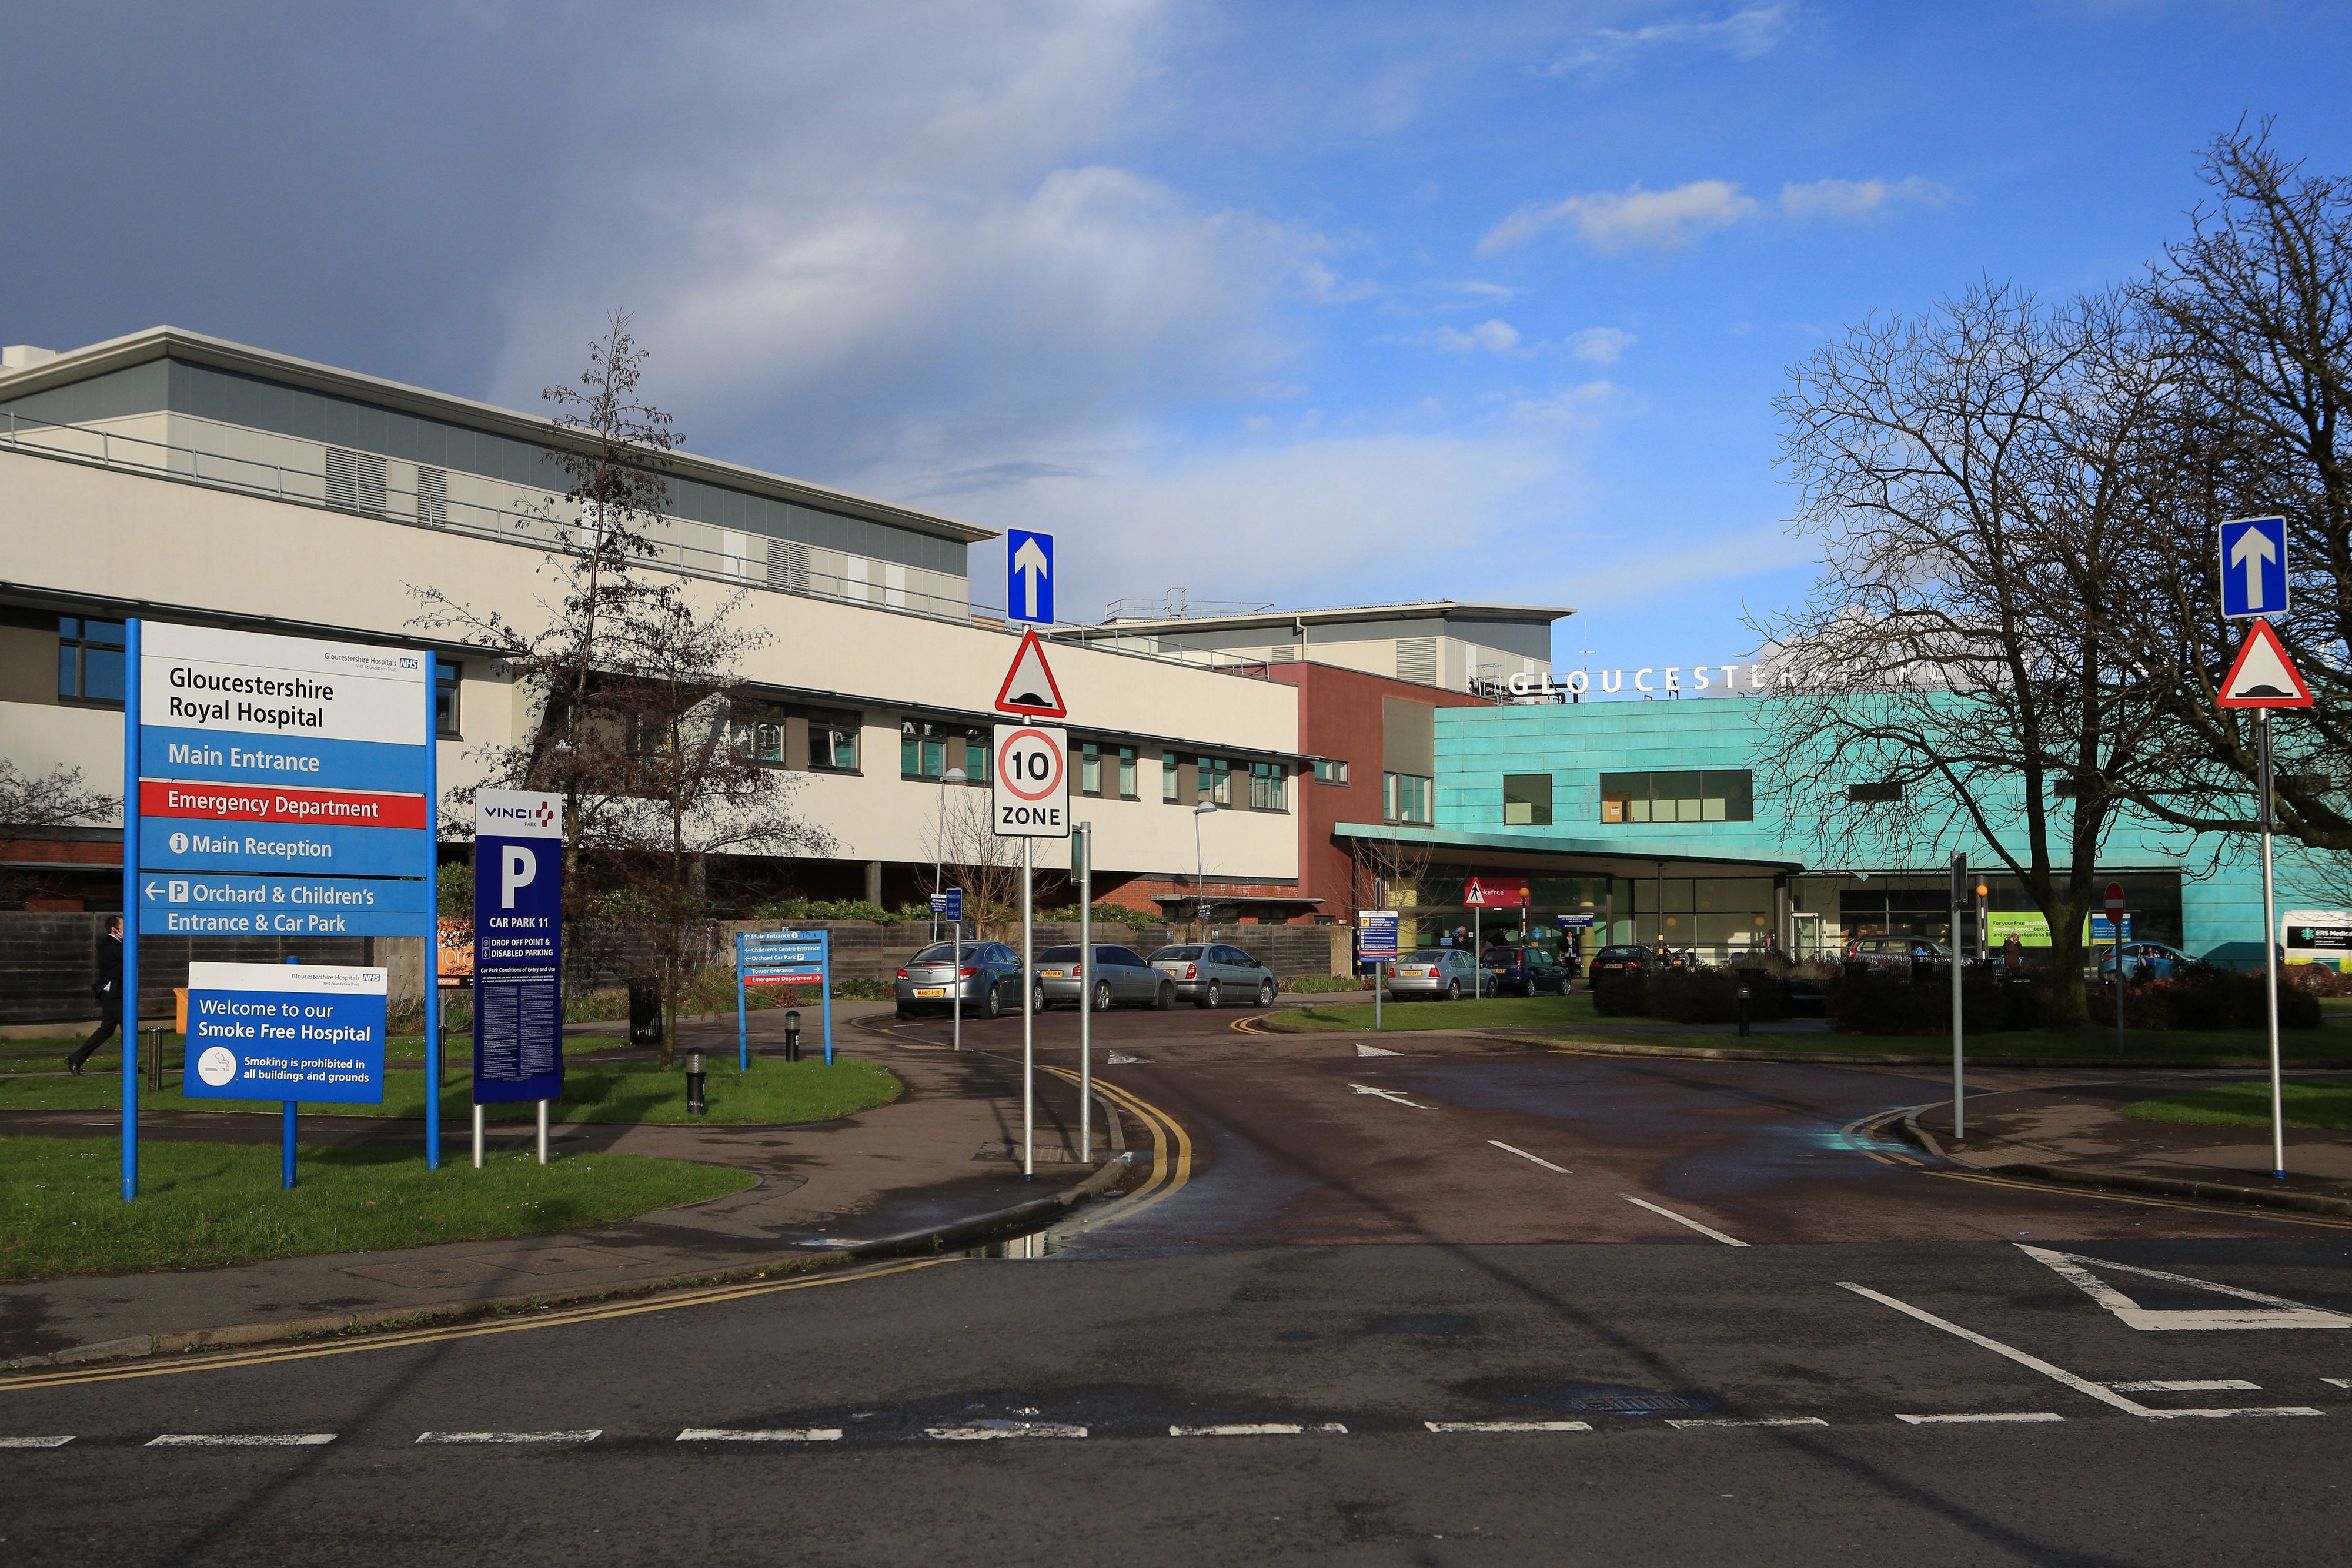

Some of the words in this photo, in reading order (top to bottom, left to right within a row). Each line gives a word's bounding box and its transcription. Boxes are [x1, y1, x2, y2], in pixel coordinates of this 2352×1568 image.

[325, 652, 369, 664] Gloucestershire
[370, 657, 396, 667] Hospitals
[400, 659, 417, 668] NHS
[169, 667, 333, 700] Gloucestershire
[169, 696, 229, 724] Royal
[238, 702, 322, 729] Hospital
[169, 743, 222, 766] Main
[230, 747, 320, 772] Entrance
[1012, 751, 1049, 780] 10
[168, 790, 270, 816] Emergency
[275, 796, 379, 818] Department
[485, 807, 532, 819] VINCI
[1003, 807, 1060, 825] ZONE
[193, 835, 239, 854] Main
[245, 837, 332, 860] Reception
[502, 845, 537, 908] P
[193, 884, 266, 903] Orchard
[272, 887, 285, 903] &
[290, 887, 374, 905] Children's
[168, 913, 249, 931] Entrance
[255, 914, 268, 931] &
[274, 914, 303, 931] Car
[309, 914, 346, 932] Park
[489, 917, 509, 928] CAR
[511, 917, 535, 928] PARK
[538, 917, 548, 928] 11
[199, 999, 276, 1016] Welcome
[281, 1003, 299, 1017] to
[305, 1006, 333, 1018] our
[199, 1022, 255, 1038] Smoke
[261, 1024, 295, 1039] Free
[302, 1025, 371, 1044] Hospital
[244, 1057, 287, 1069] Smoking
[290, 1058, 298, 1067] is
[300, 1059, 353, 1070] prohibited
[356, 1060, 365, 1069] in
[243, 1069, 255, 1079] all
[258, 1070, 304, 1082] buildings
[307, 1072, 326, 1081] and
[328, 1073, 369, 1084] grounds
